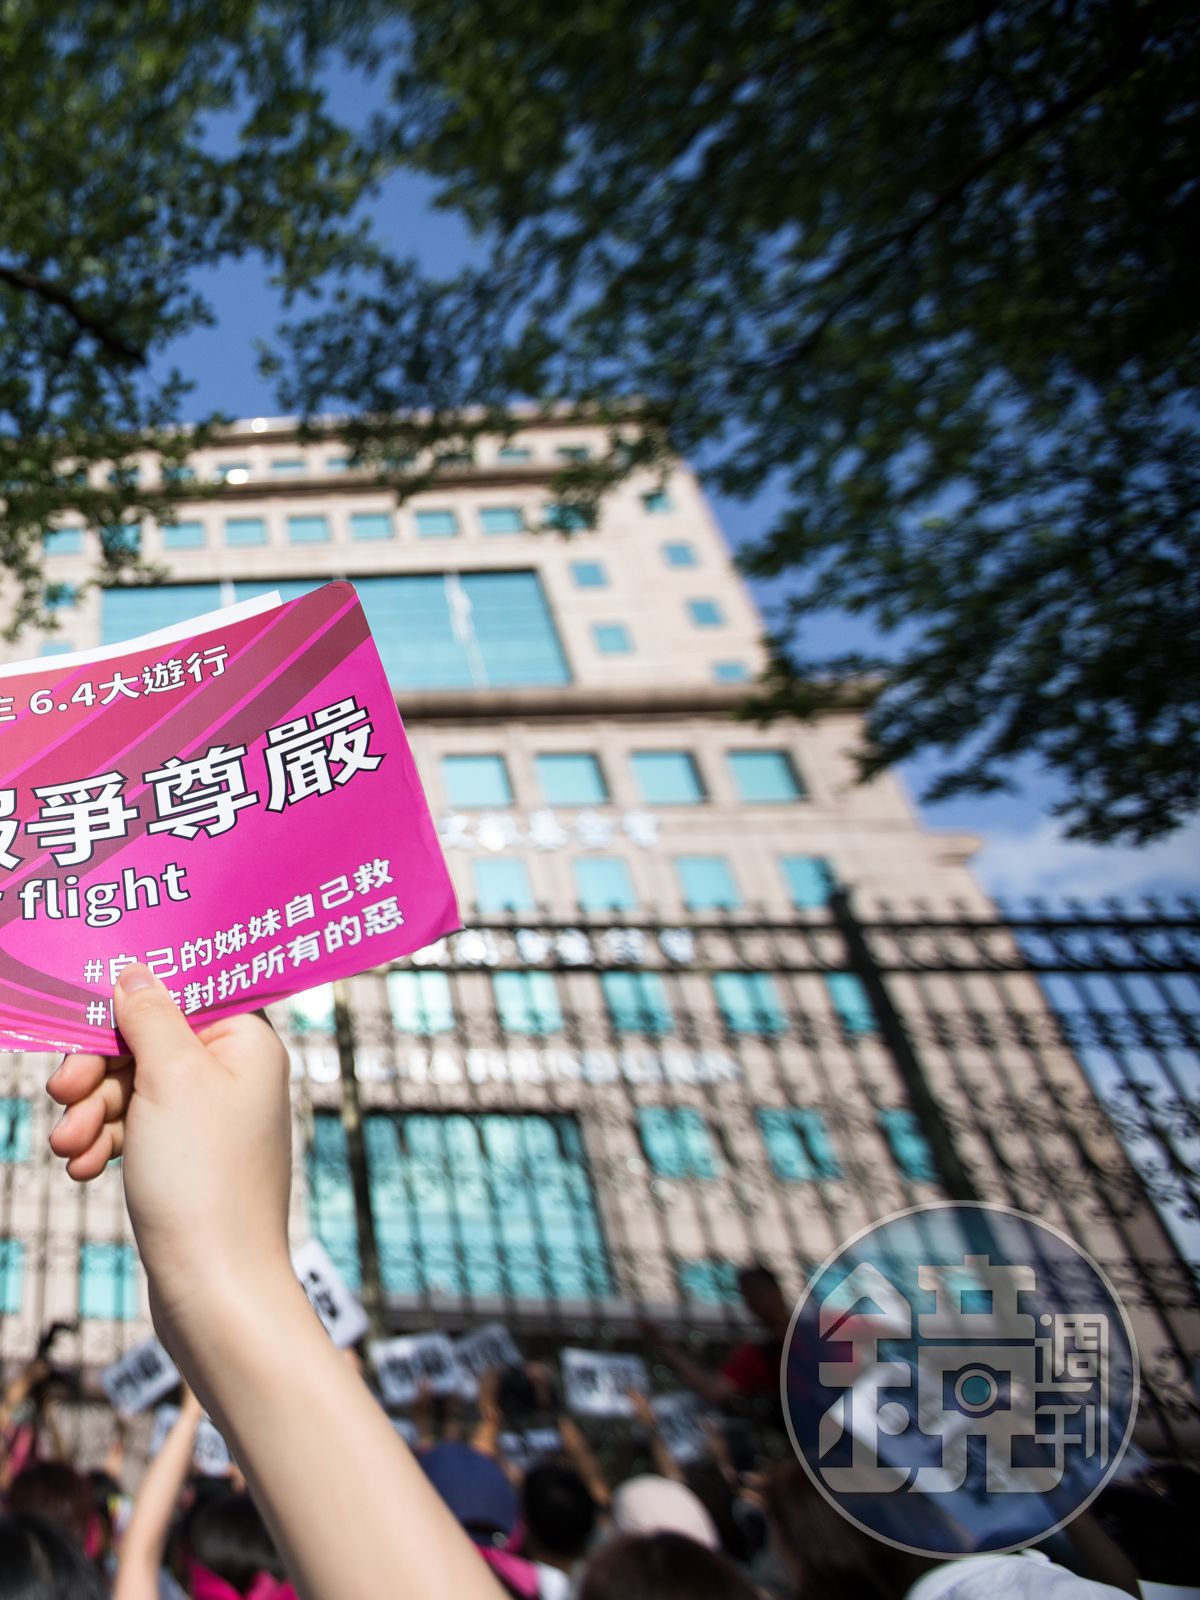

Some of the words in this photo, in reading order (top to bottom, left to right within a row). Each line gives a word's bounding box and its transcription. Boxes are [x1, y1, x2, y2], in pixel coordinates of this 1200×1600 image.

[29, 644, 229, 716] 6.4大遊行
[19, 862, 191, 928] flight
[85, 896, 405, 1029] #對抗所有的惡
